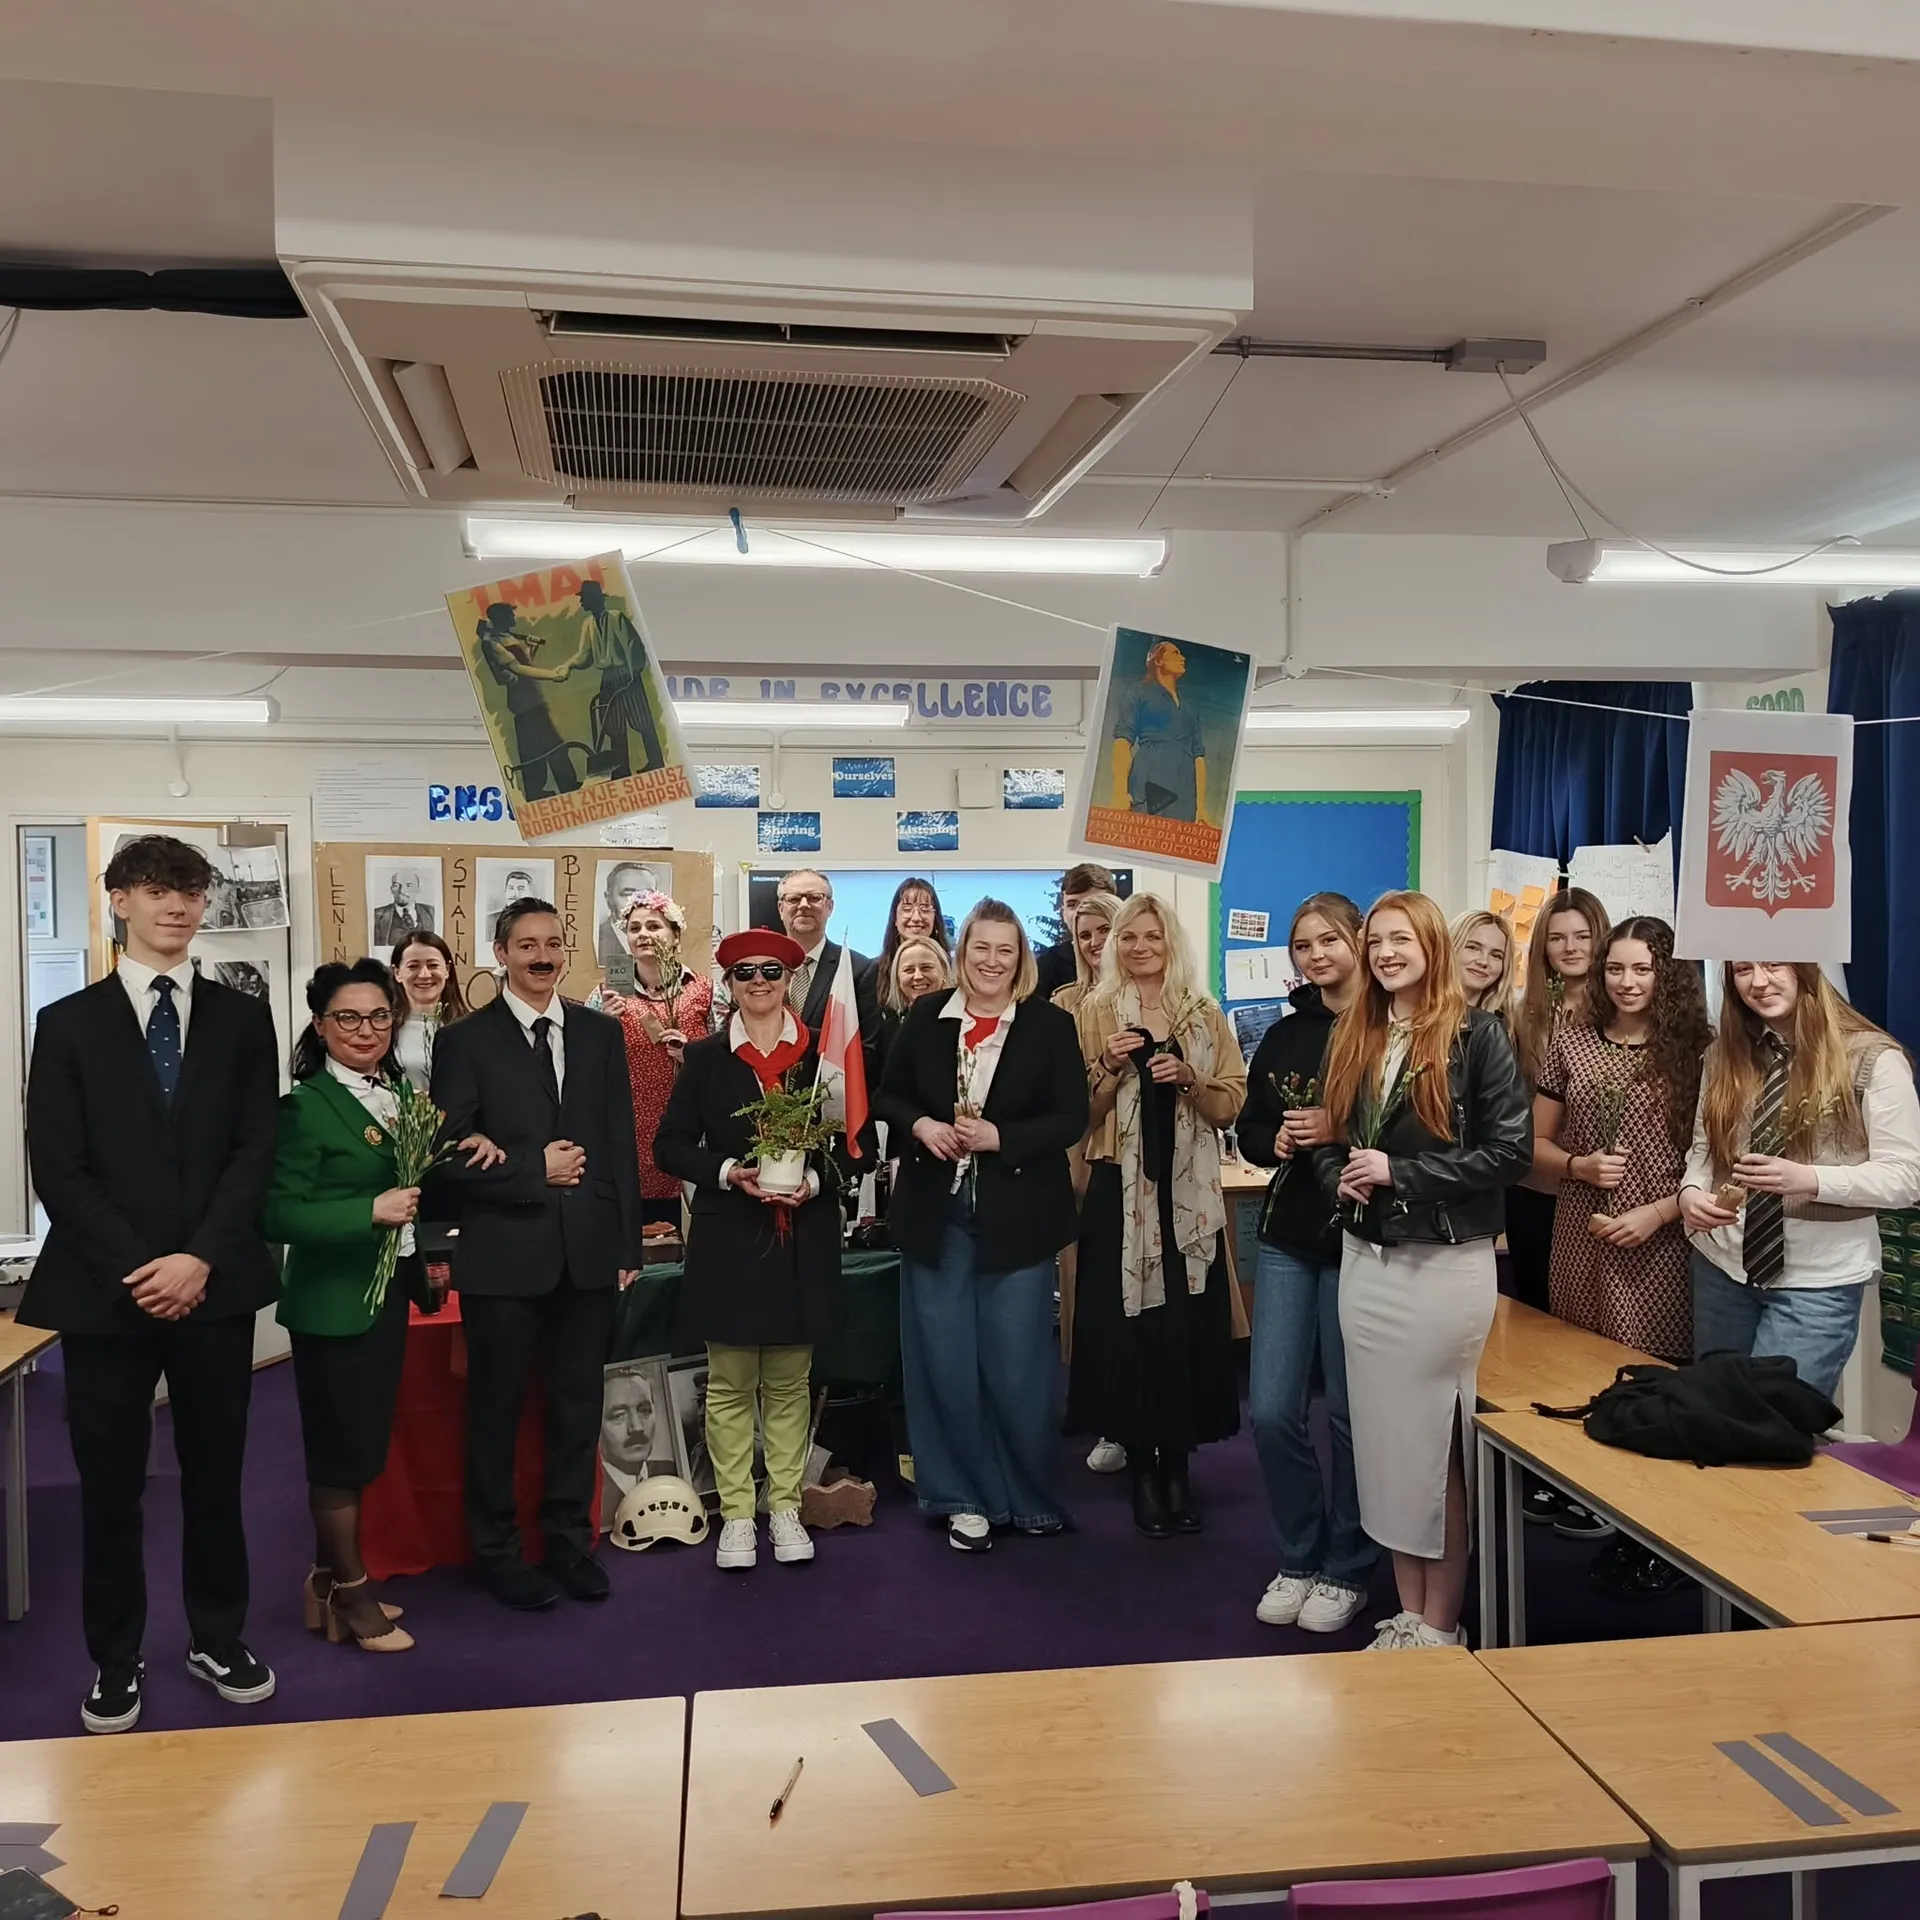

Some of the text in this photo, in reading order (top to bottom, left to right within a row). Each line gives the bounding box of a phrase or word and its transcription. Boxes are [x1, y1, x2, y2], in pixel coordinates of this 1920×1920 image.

[666, 676, 730, 699] IDE
[834, 771, 894, 781] Ourselves
[429, 784, 516, 821] ENG
[517, 793, 576, 822] NIECH
[623, 765, 688, 794] SOJUSZ
[764, 825, 816, 837] Sharing
[899, 825, 957, 836] Listening
[1157, 830, 1177, 842] DLA
[1179, 834, 1220, 850] POKOJU
[561, 854, 581, 968] BIERUT
[610, 967, 627, 975] PKO
